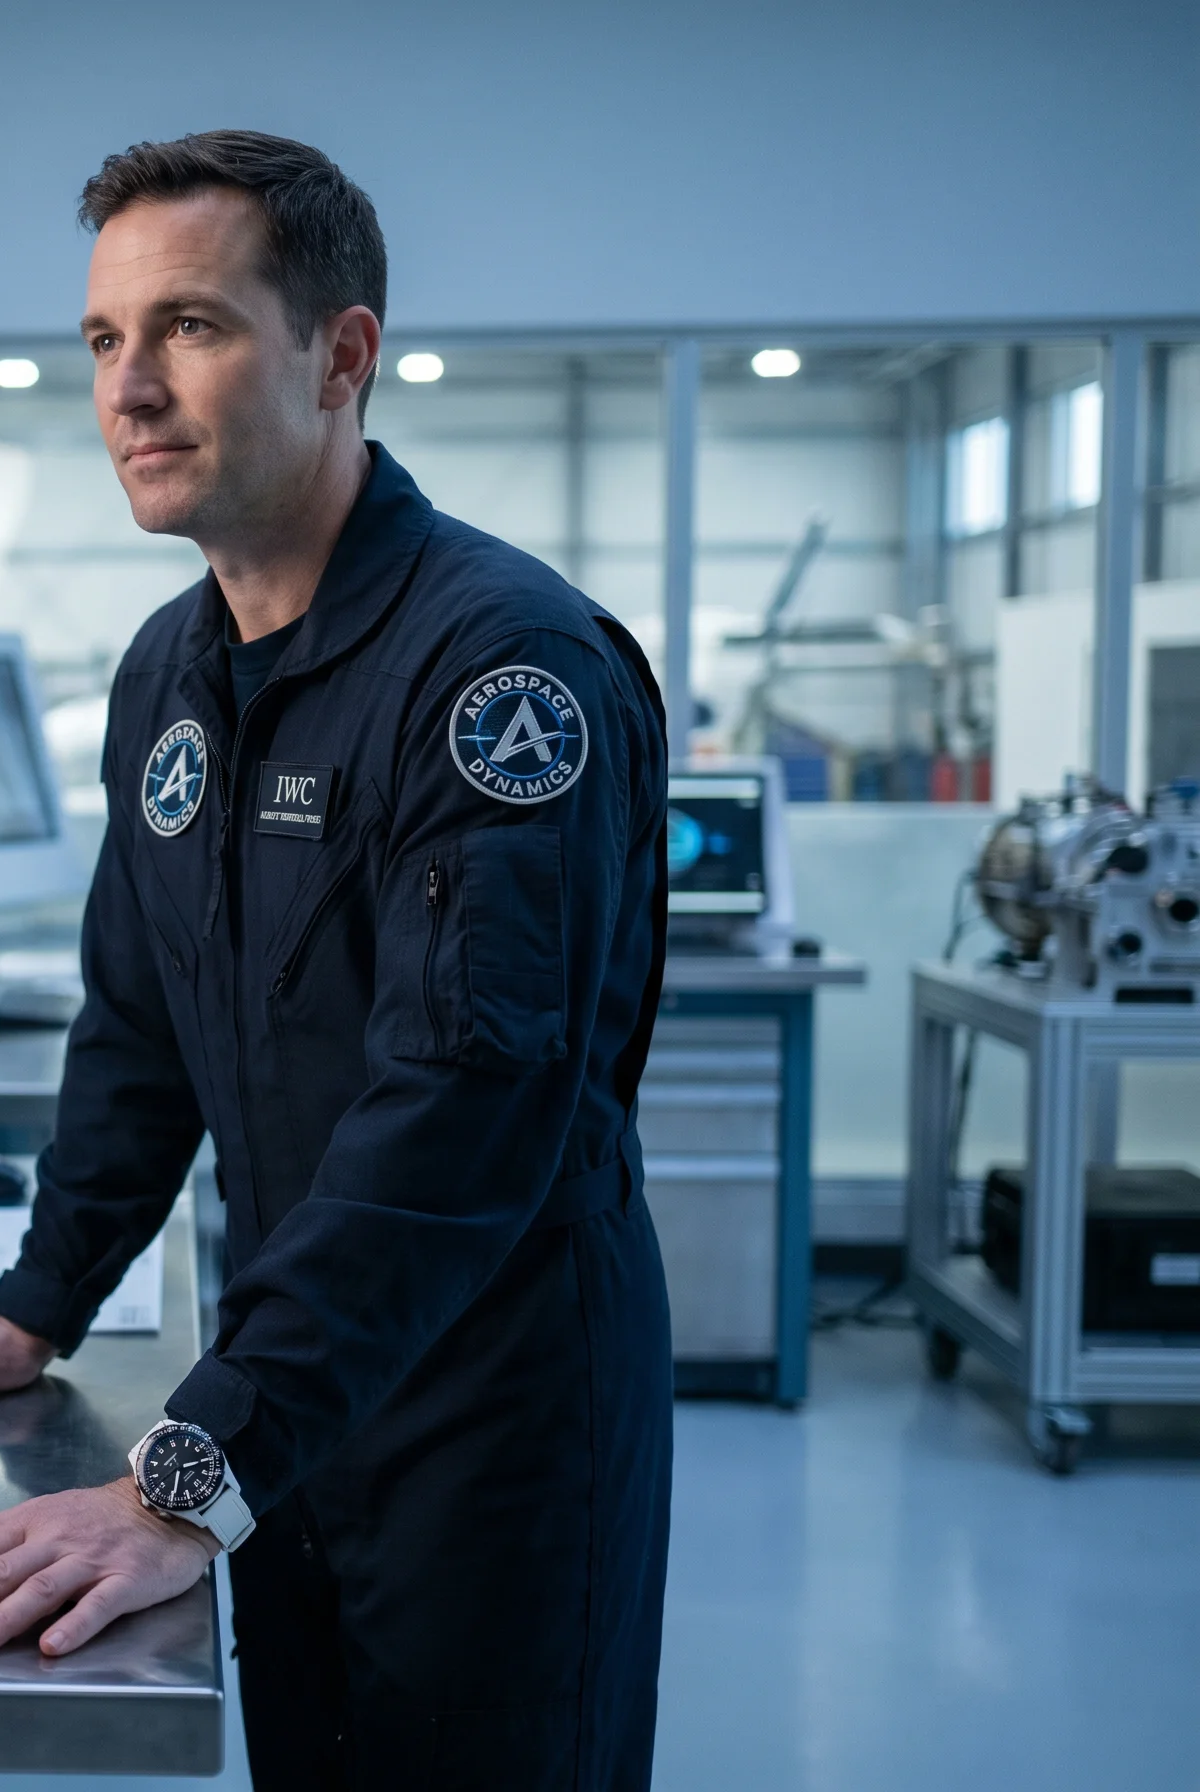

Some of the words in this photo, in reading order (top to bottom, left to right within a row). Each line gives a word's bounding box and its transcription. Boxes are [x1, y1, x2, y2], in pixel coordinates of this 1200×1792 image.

[464, 674, 575, 721] AEROSPACE
[273, 775, 317, 806] IWC
[468, 758, 573, 796] DYNAMICS
